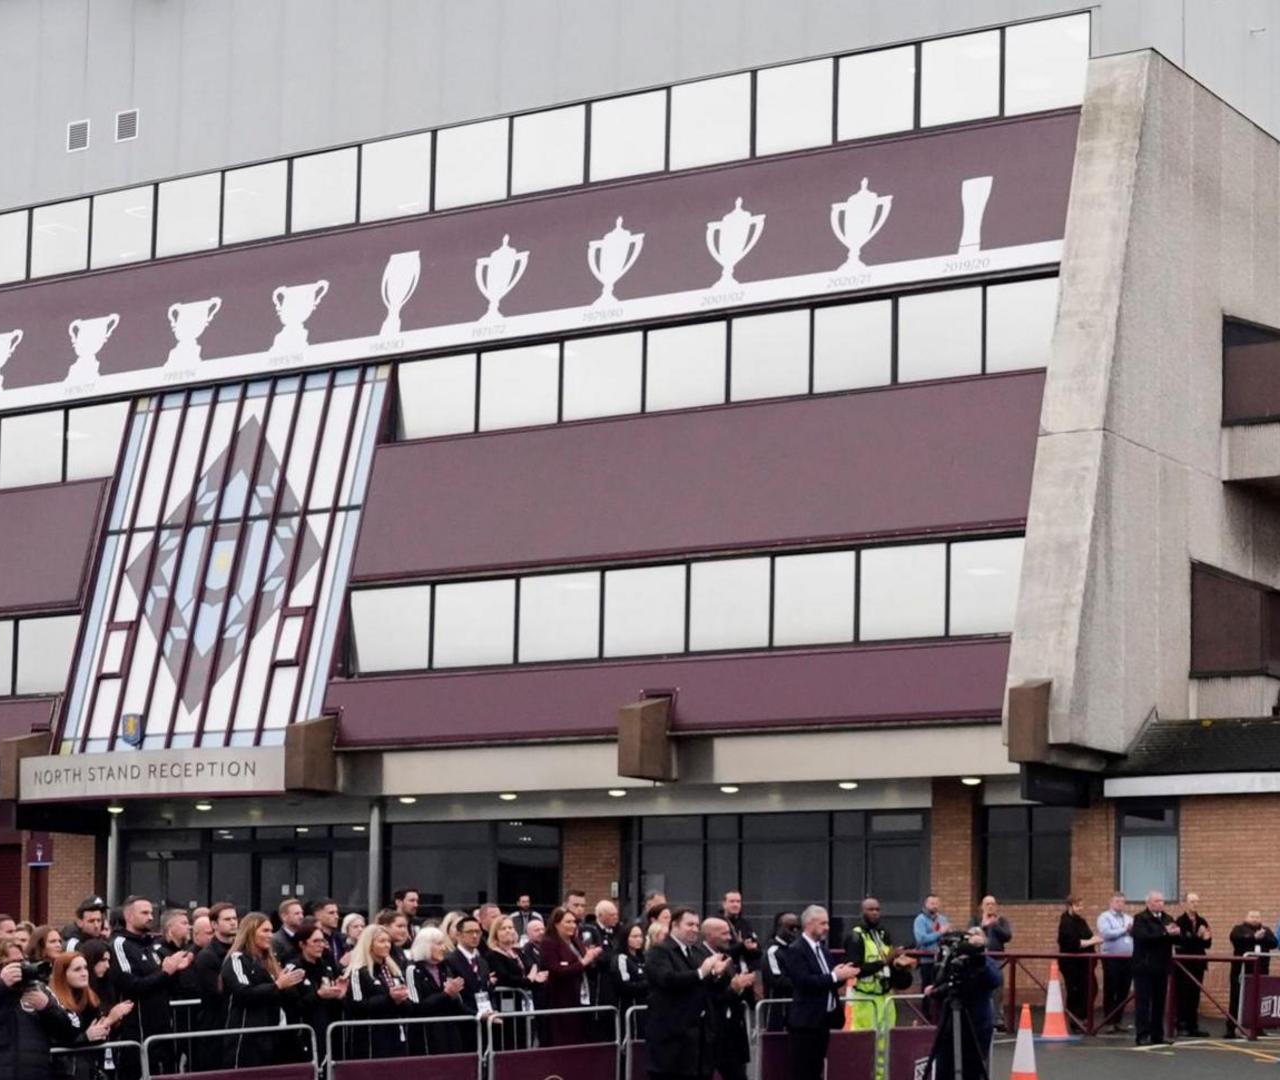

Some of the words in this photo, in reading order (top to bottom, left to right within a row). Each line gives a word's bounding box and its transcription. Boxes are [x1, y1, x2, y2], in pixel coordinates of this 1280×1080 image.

[34, 767, 82, 786] NORTH
[88, 764, 141, 782] STAND
[148, 761, 256, 779] RECEPTION
